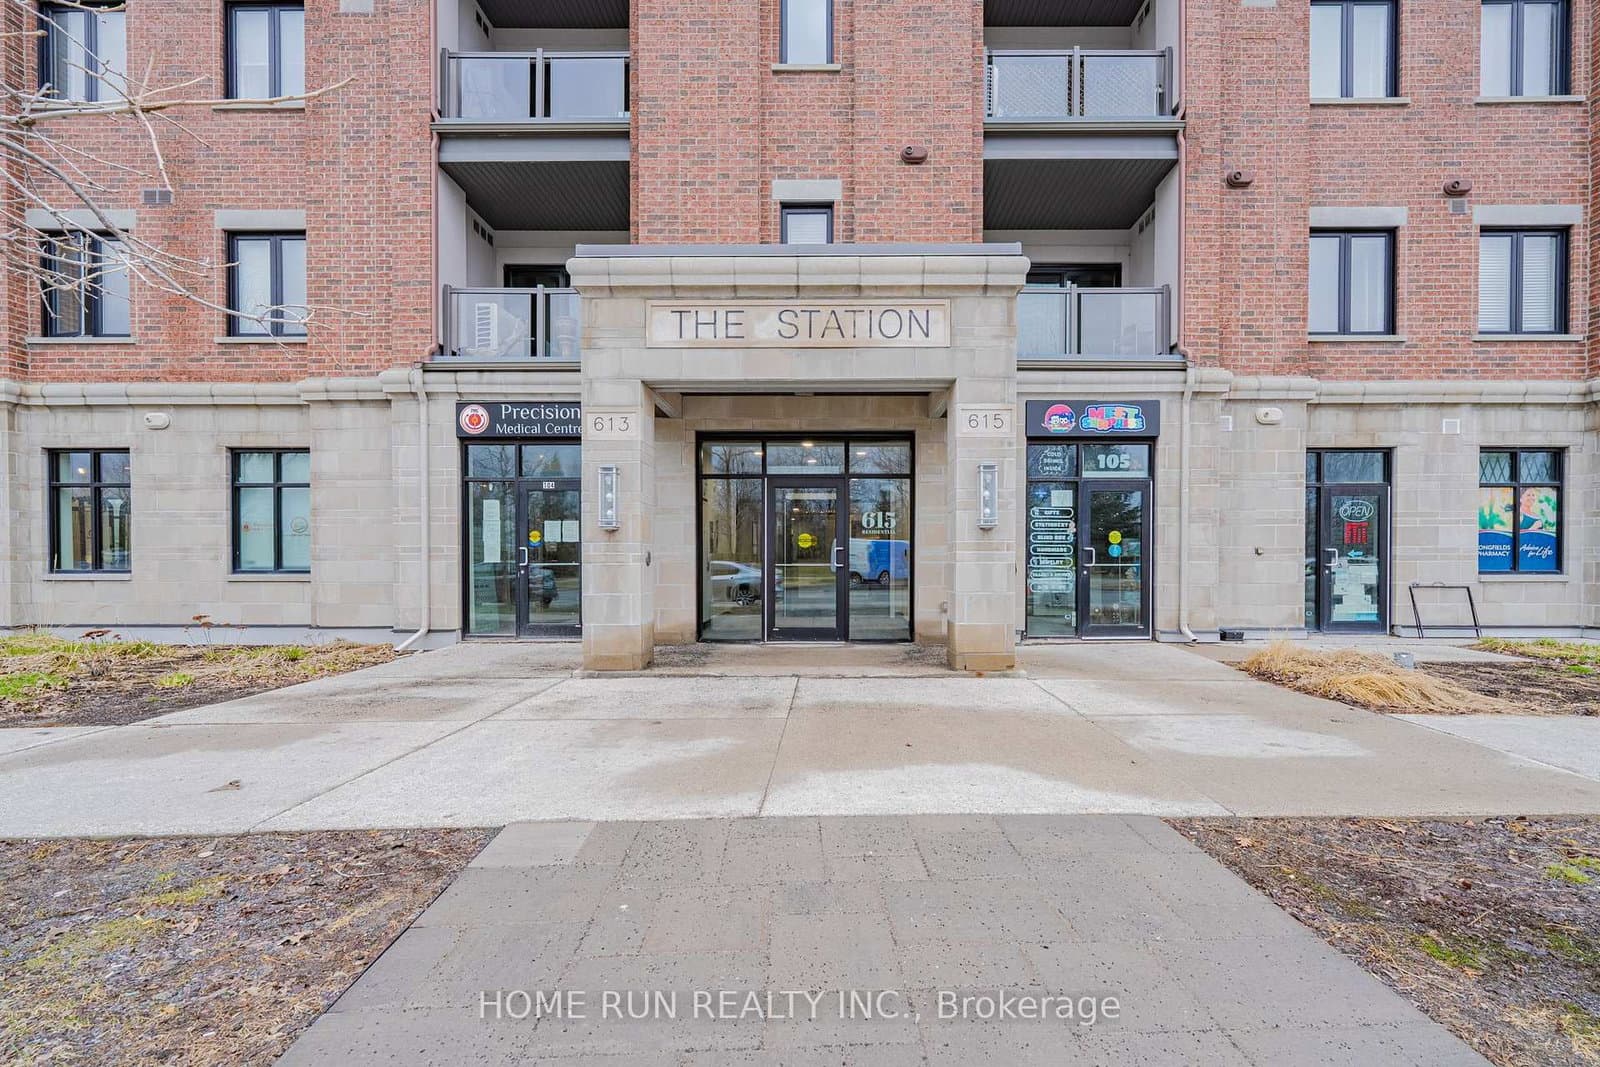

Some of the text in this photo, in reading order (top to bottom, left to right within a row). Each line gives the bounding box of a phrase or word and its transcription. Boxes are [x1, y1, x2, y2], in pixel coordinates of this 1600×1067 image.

[671, 309, 930, 339] THE STATION
[501, 404, 581, 420] Precision
[1088, 406, 1139, 419] MEET
[495, 423, 541, 434] Medical
[593, 416, 630, 432] 613
[968, 413, 1005, 429] 615
[1097, 454, 1131, 469] 105
[1341, 505, 1371, 517] OPEN
[861, 511, 897, 529] 615
[1536, 545, 1554, 559] Life
